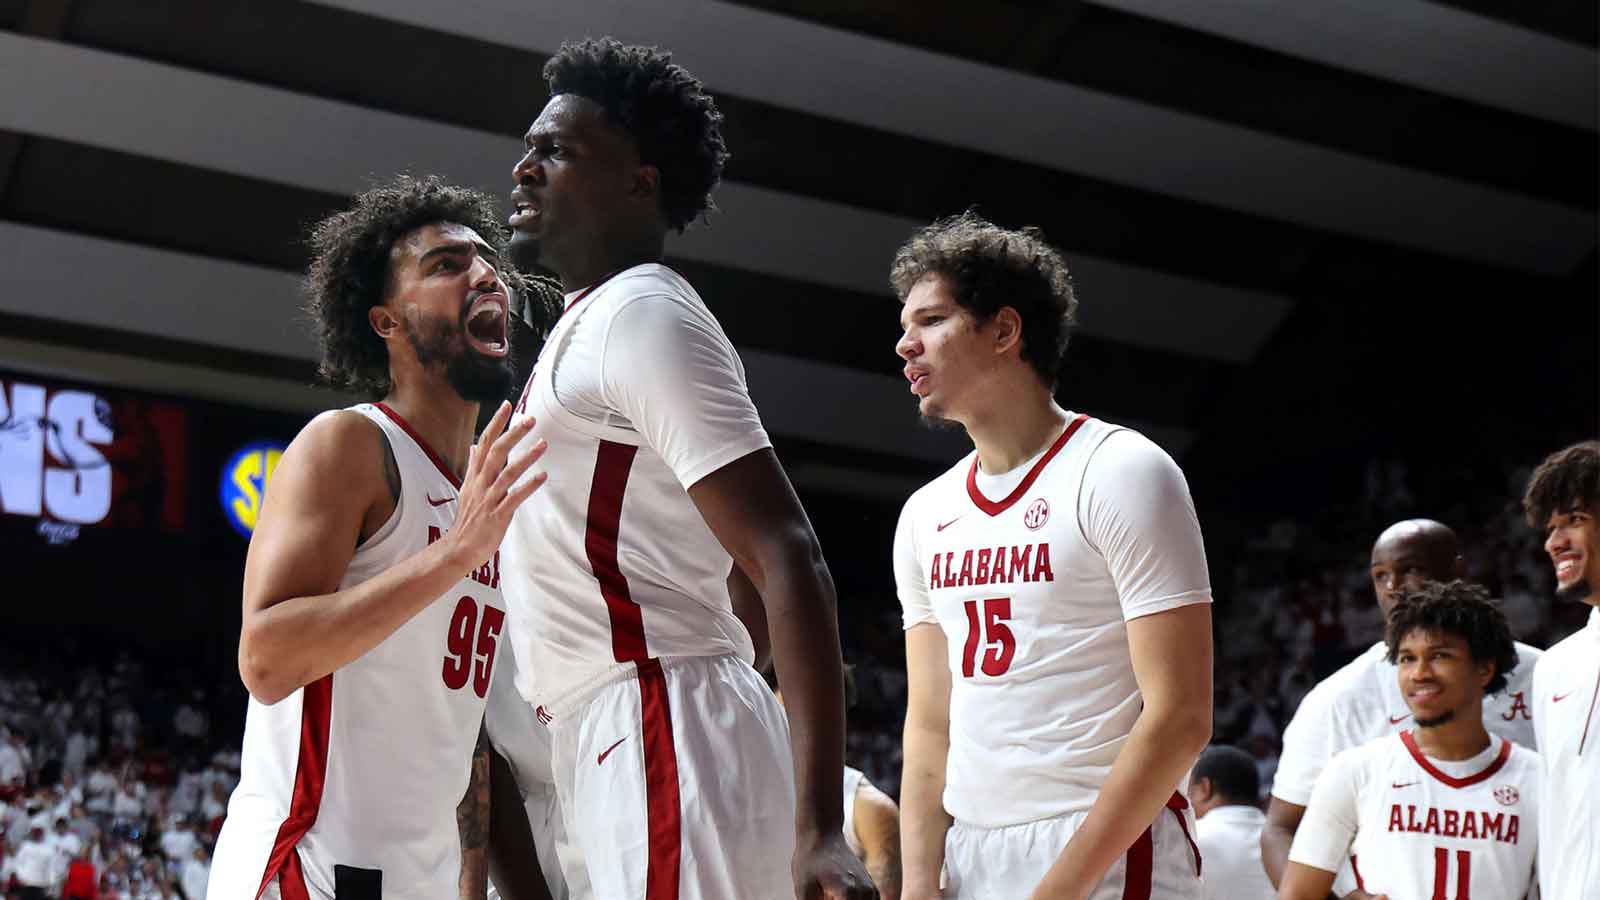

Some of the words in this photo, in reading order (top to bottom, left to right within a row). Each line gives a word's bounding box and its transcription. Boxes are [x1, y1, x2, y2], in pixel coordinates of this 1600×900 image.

[930, 543, 1054, 590] ALABAMA
[442, 596, 505, 698] 95
[962, 598, 1016, 678] 15
[1388, 804, 1520, 845] ALABAMA
[1432, 847, 1471, 900] 11
